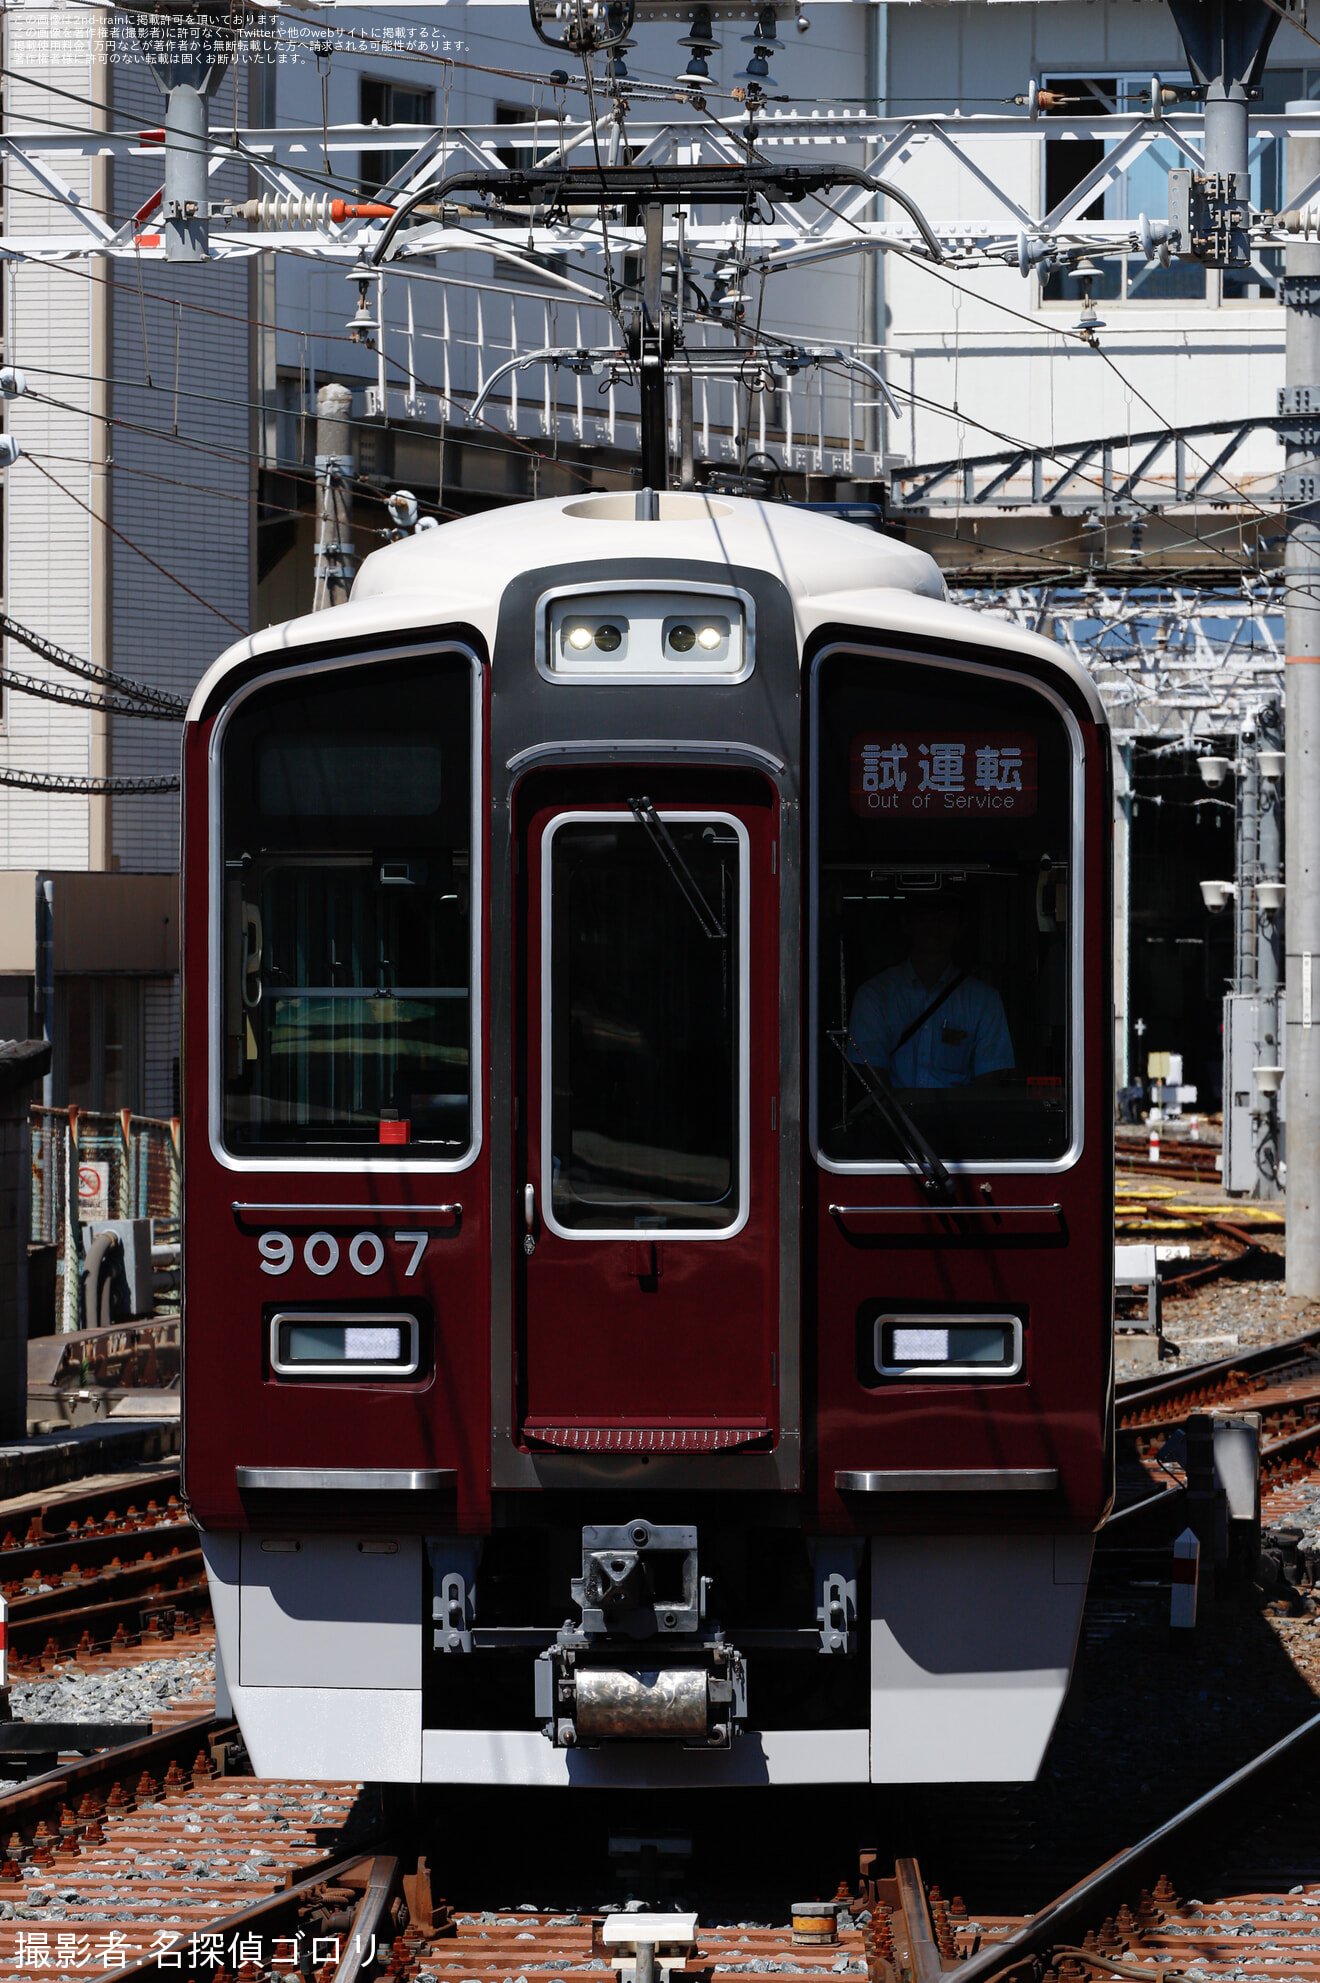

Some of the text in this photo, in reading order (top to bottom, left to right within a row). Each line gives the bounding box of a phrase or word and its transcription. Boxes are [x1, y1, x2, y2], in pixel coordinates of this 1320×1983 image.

[861, 743, 1023, 792] 試運転
[868, 793, 1014, 808] Out of Service
[258, 1231, 429, 1276] 9007
